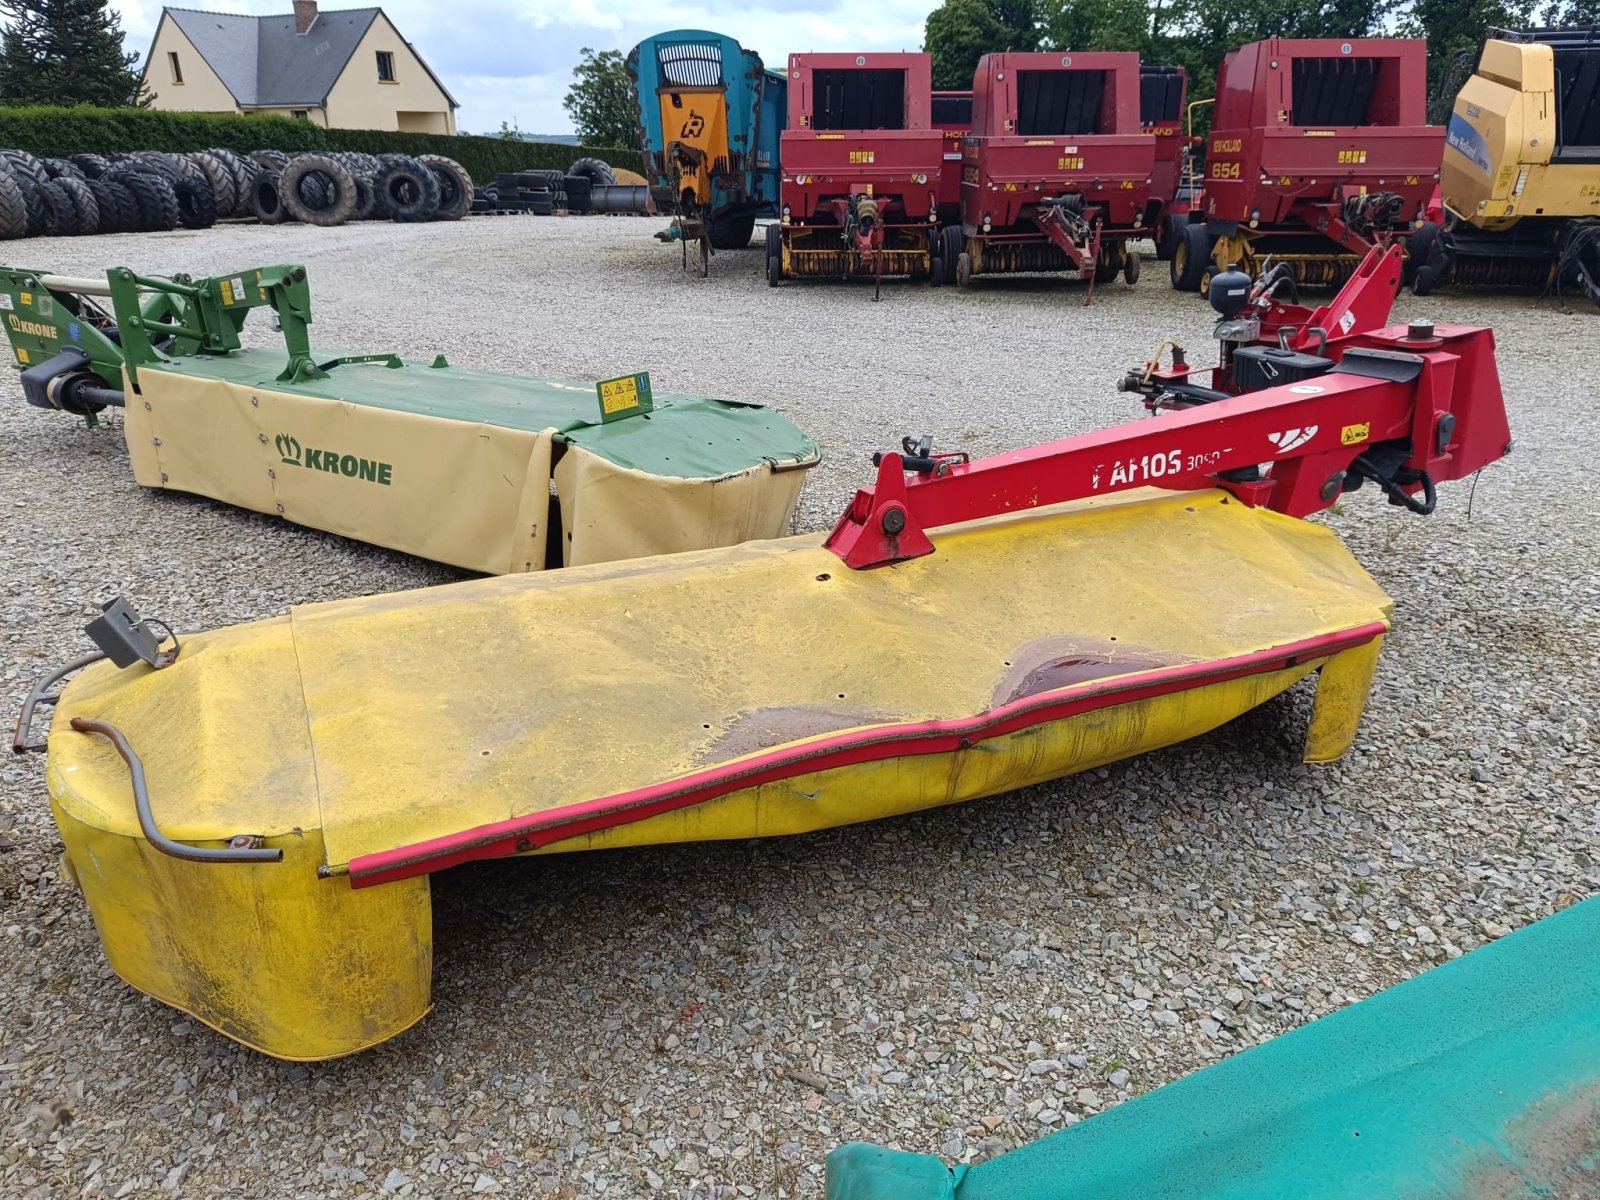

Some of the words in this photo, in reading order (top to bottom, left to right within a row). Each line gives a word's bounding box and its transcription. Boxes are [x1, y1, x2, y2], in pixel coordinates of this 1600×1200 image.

[1212, 163, 1240, 178] 654
[20, 320, 58, 339] KRONE
[305, 447, 392, 486] KRONE
